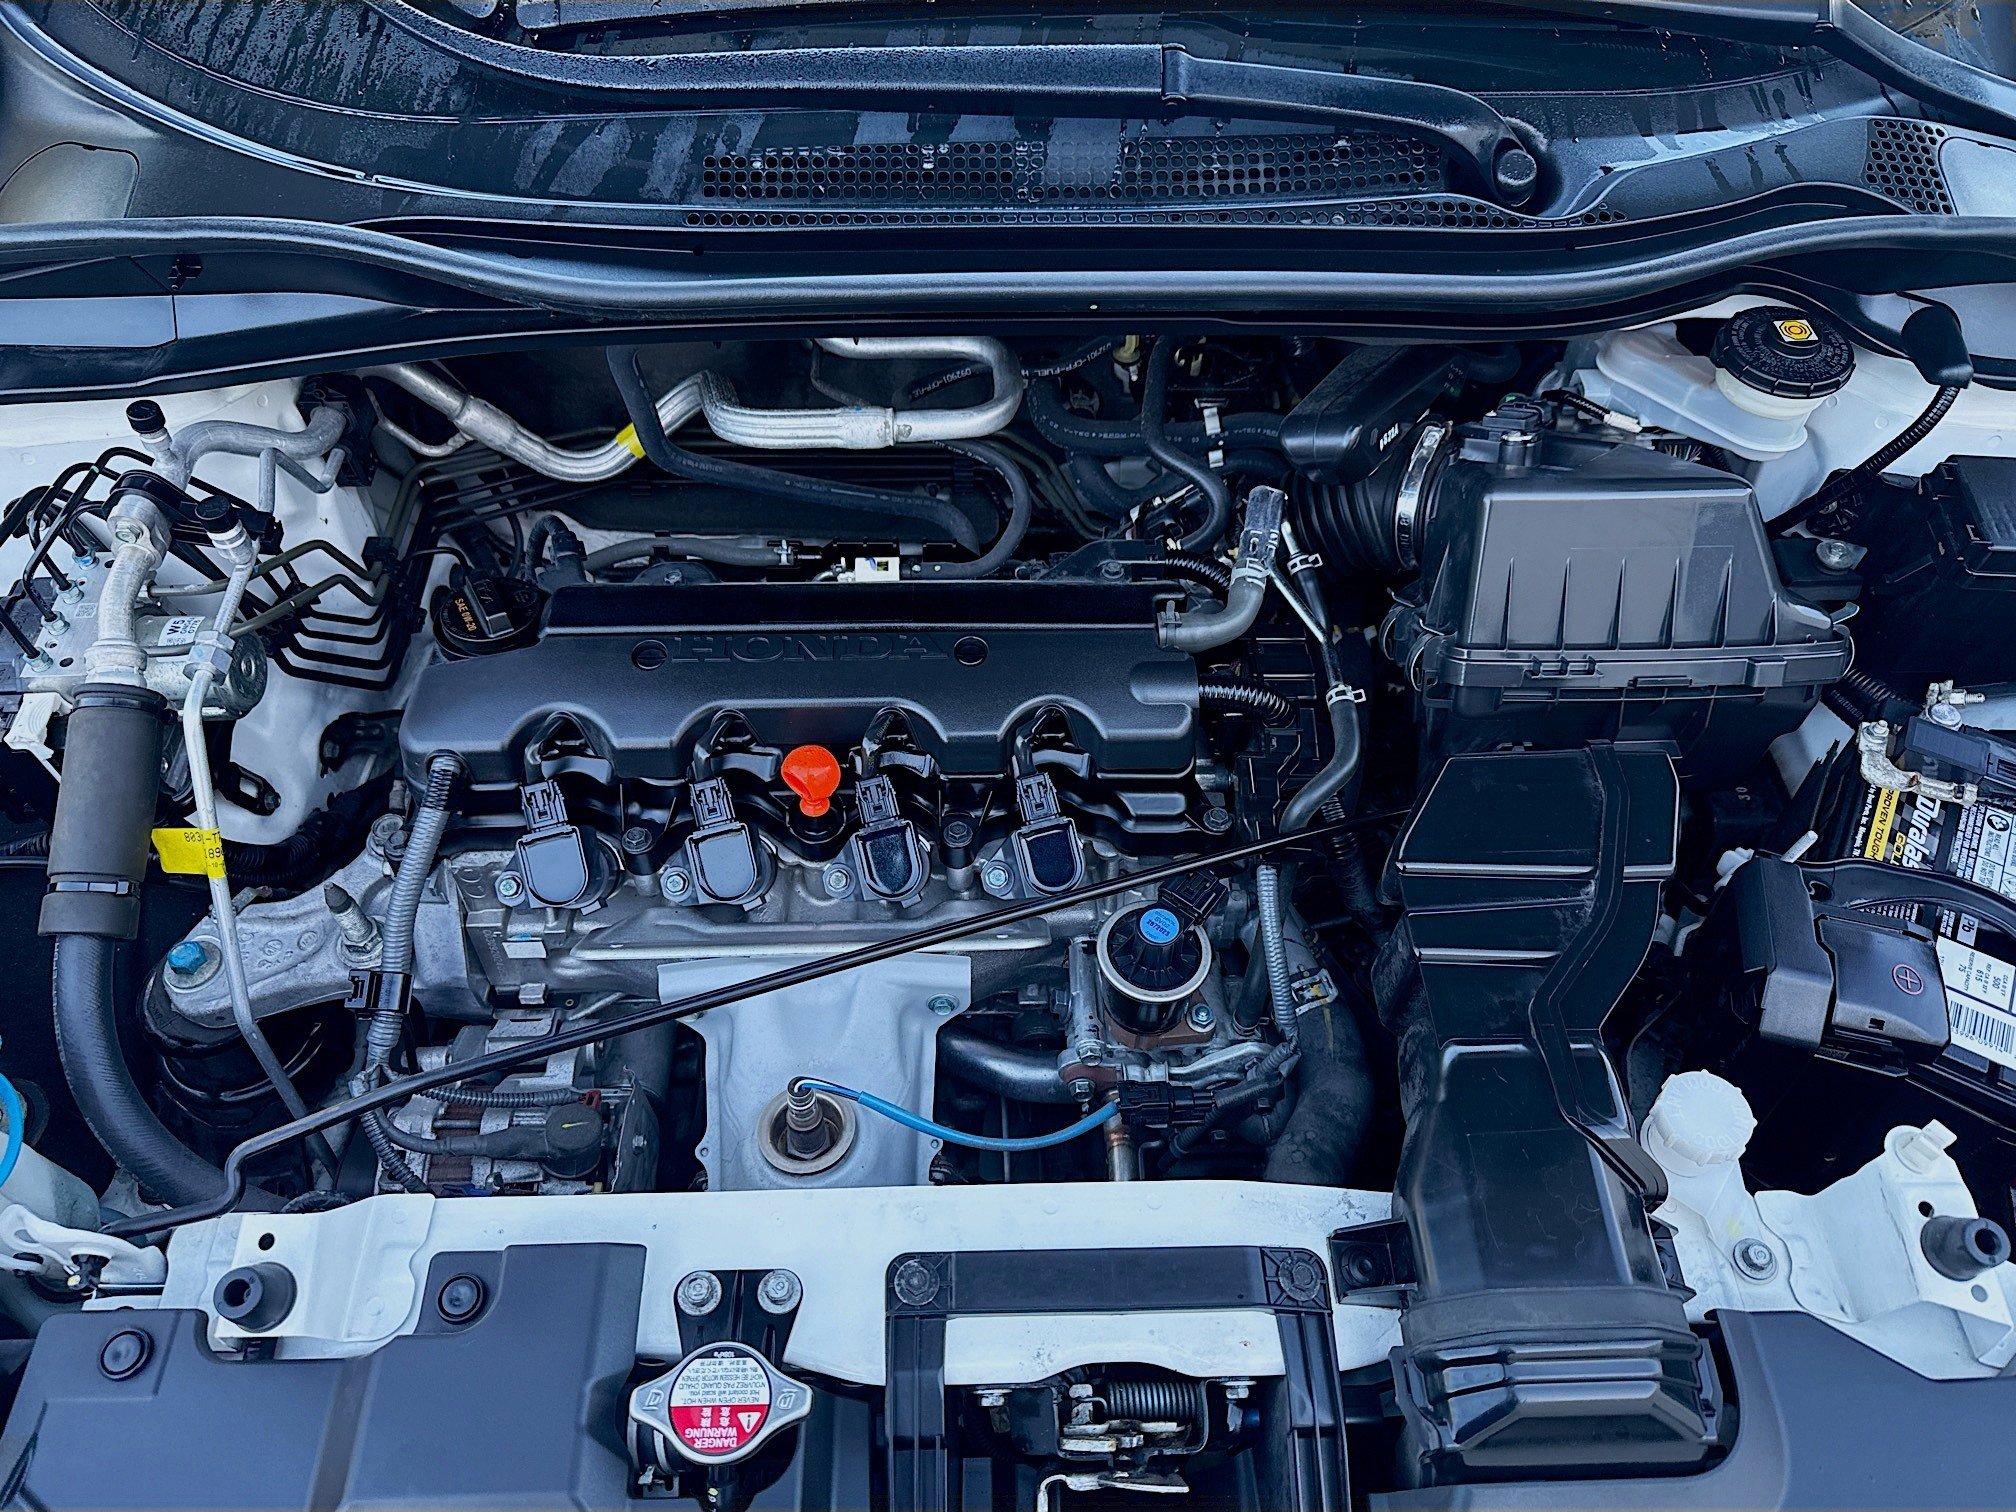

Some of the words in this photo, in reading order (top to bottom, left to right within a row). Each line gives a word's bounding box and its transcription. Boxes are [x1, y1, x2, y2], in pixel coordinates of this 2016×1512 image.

[454, 598, 468, 613] SAE
[461, 611, 477, 631] 0W-20
[671, 633, 948, 663] HONDA
[1878, 789, 1895, 828] PROVEN
[1902, 794, 1941, 870] Duralas
[1961, 917, 1976, 934] Pb
[1958, 963, 1967, 973] 75
[1975, 969, 1984, 982] 615
[1992, 976, 2001, 989] 500
[685, 1427, 737, 1438] WARNUNG
[694, 1438, 737, 1448] DANGER
